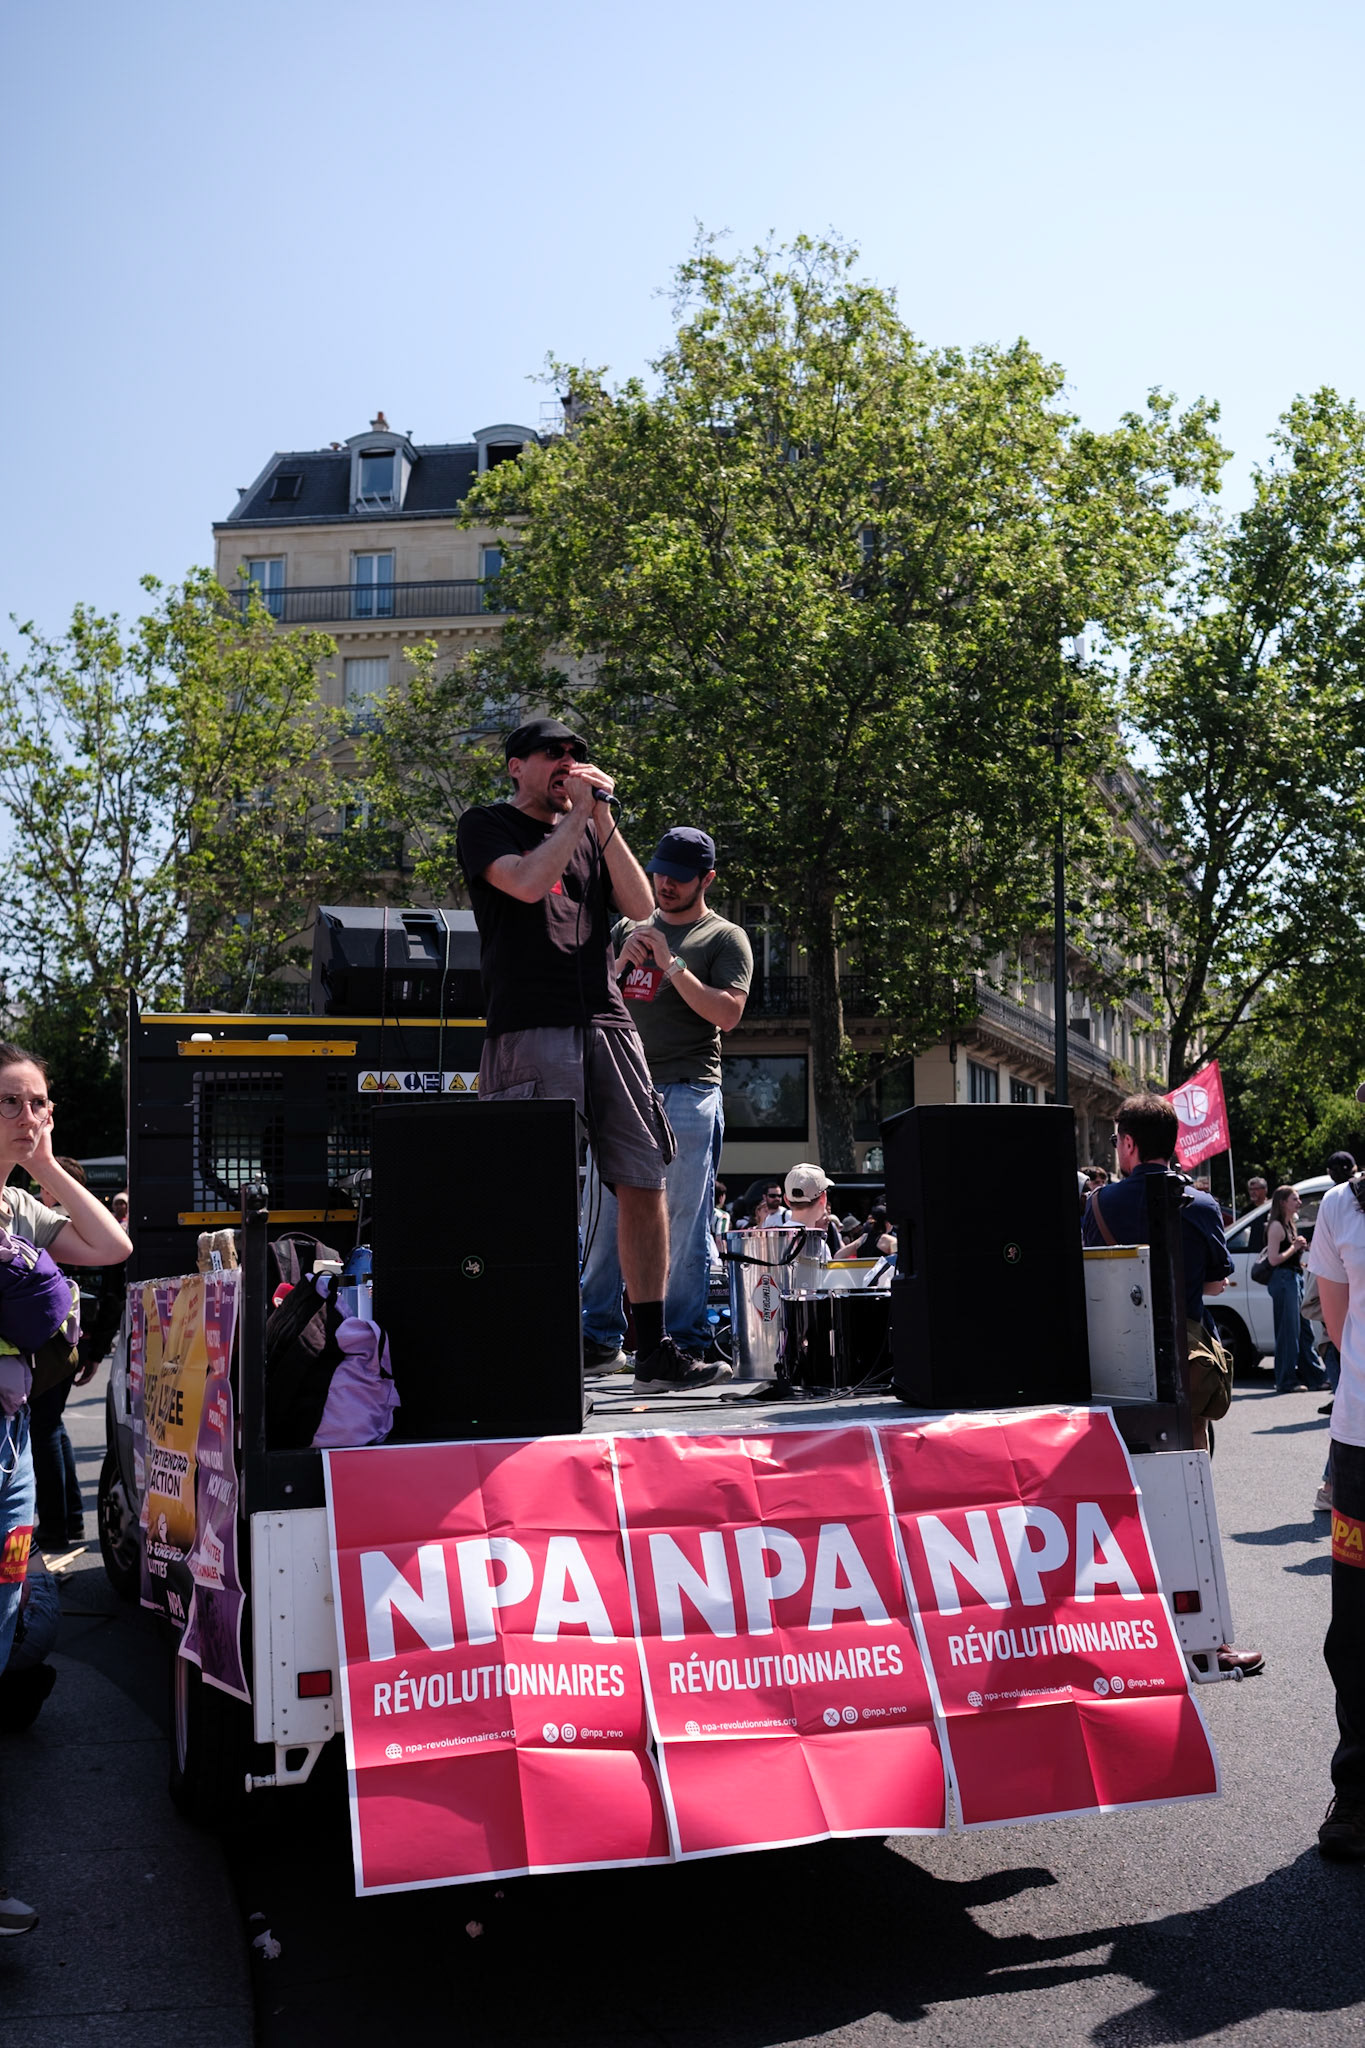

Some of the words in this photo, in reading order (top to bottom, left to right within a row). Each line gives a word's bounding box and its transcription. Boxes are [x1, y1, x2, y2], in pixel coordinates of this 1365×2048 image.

[626, 969, 653, 988] NPA
[916, 1502, 1145, 1616] NPA
[648, 1523, 892, 1641] NPA
[360, 1536, 618, 1662] NPA
[948, 1619, 1158, 1666] RÉVOLUTIONNAIRES
[669, 1644, 904, 1694] RÉVOLUTIONNAIRES
[373, 1663, 625, 1717] RÉVOLUTIONNAIRES
[983, 1684, 1073, 1702] npa-revolutionnaires.org
[1127, 1678, 1165, 1689] @npa_revo
[701, 1717, 798, 1732] npa-revolutionnaires.org
[862, 1705, 907, 1719] @npa_revo
[405, 1729, 517, 1754] npa-revolutionnaires.org
[580, 1728, 624, 1740] @npa_revo
